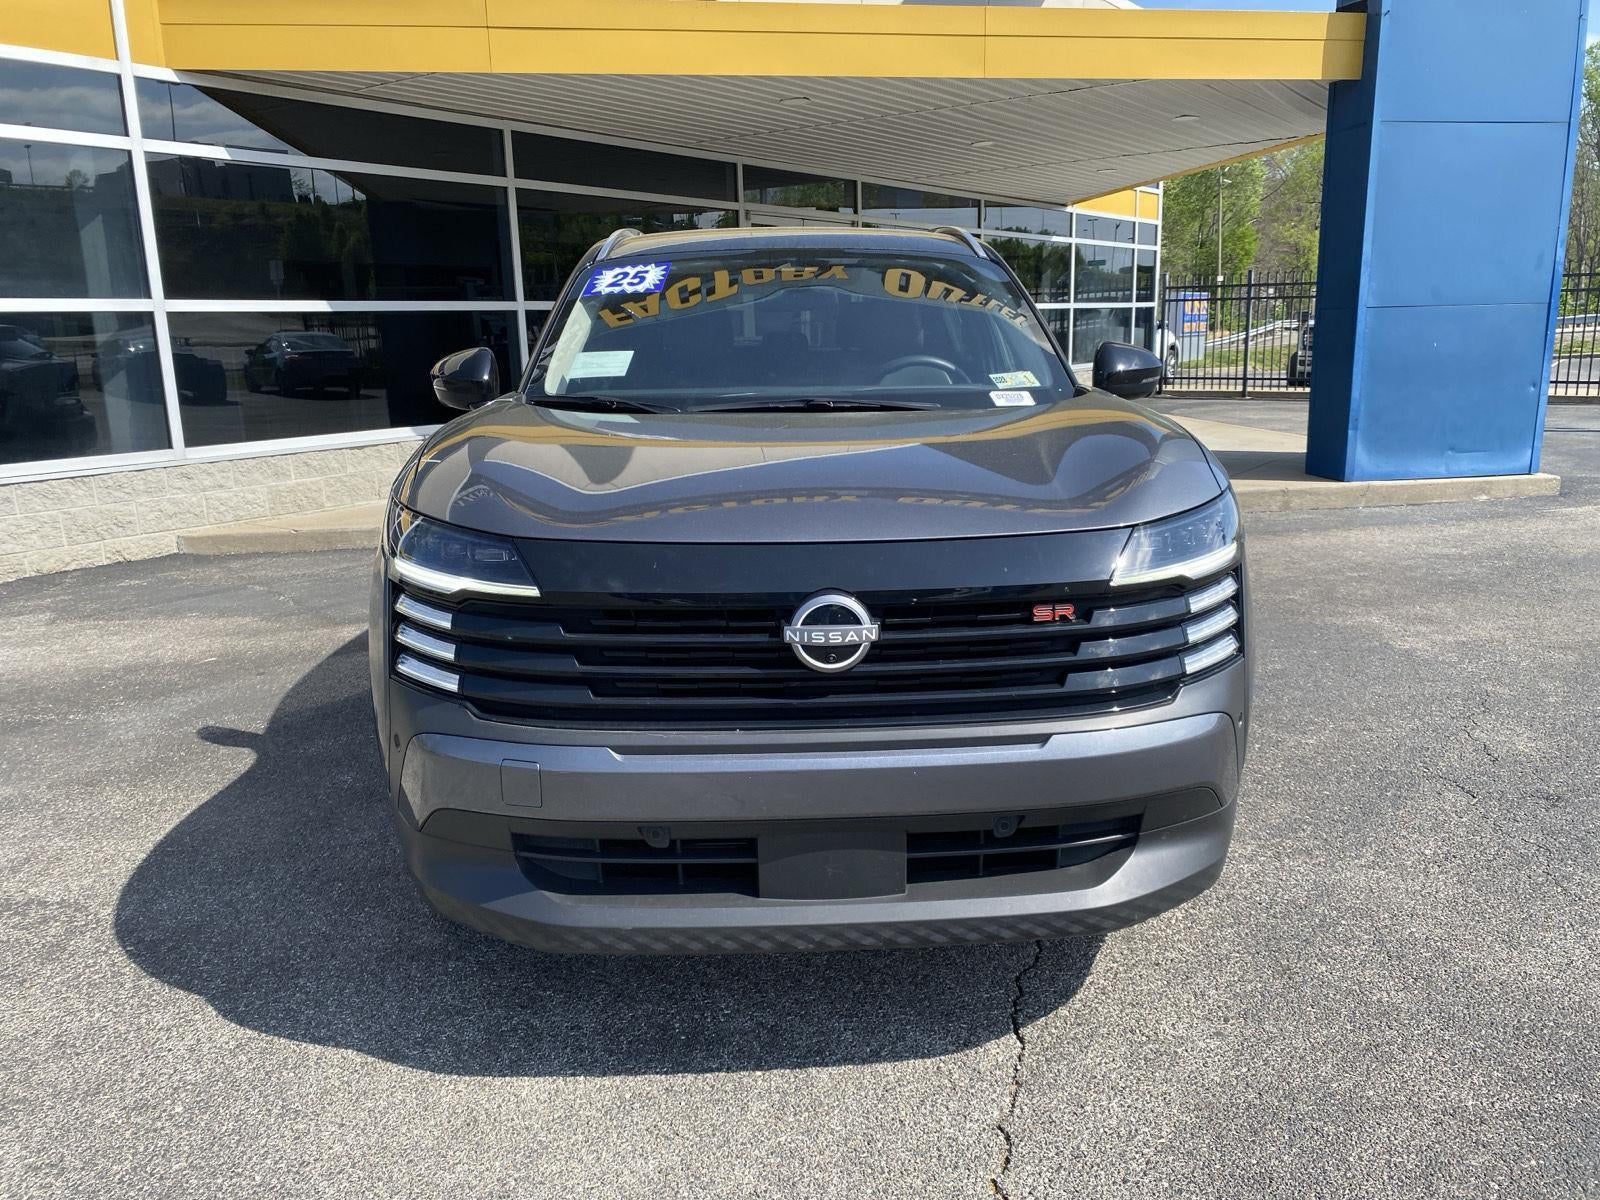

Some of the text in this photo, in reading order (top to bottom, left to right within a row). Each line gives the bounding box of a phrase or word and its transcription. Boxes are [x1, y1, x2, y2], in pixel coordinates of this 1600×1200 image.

[606, 269, 649, 287] 25
[1032, 603, 1076, 622] SR
[784, 627, 877, 644] NISSAN
